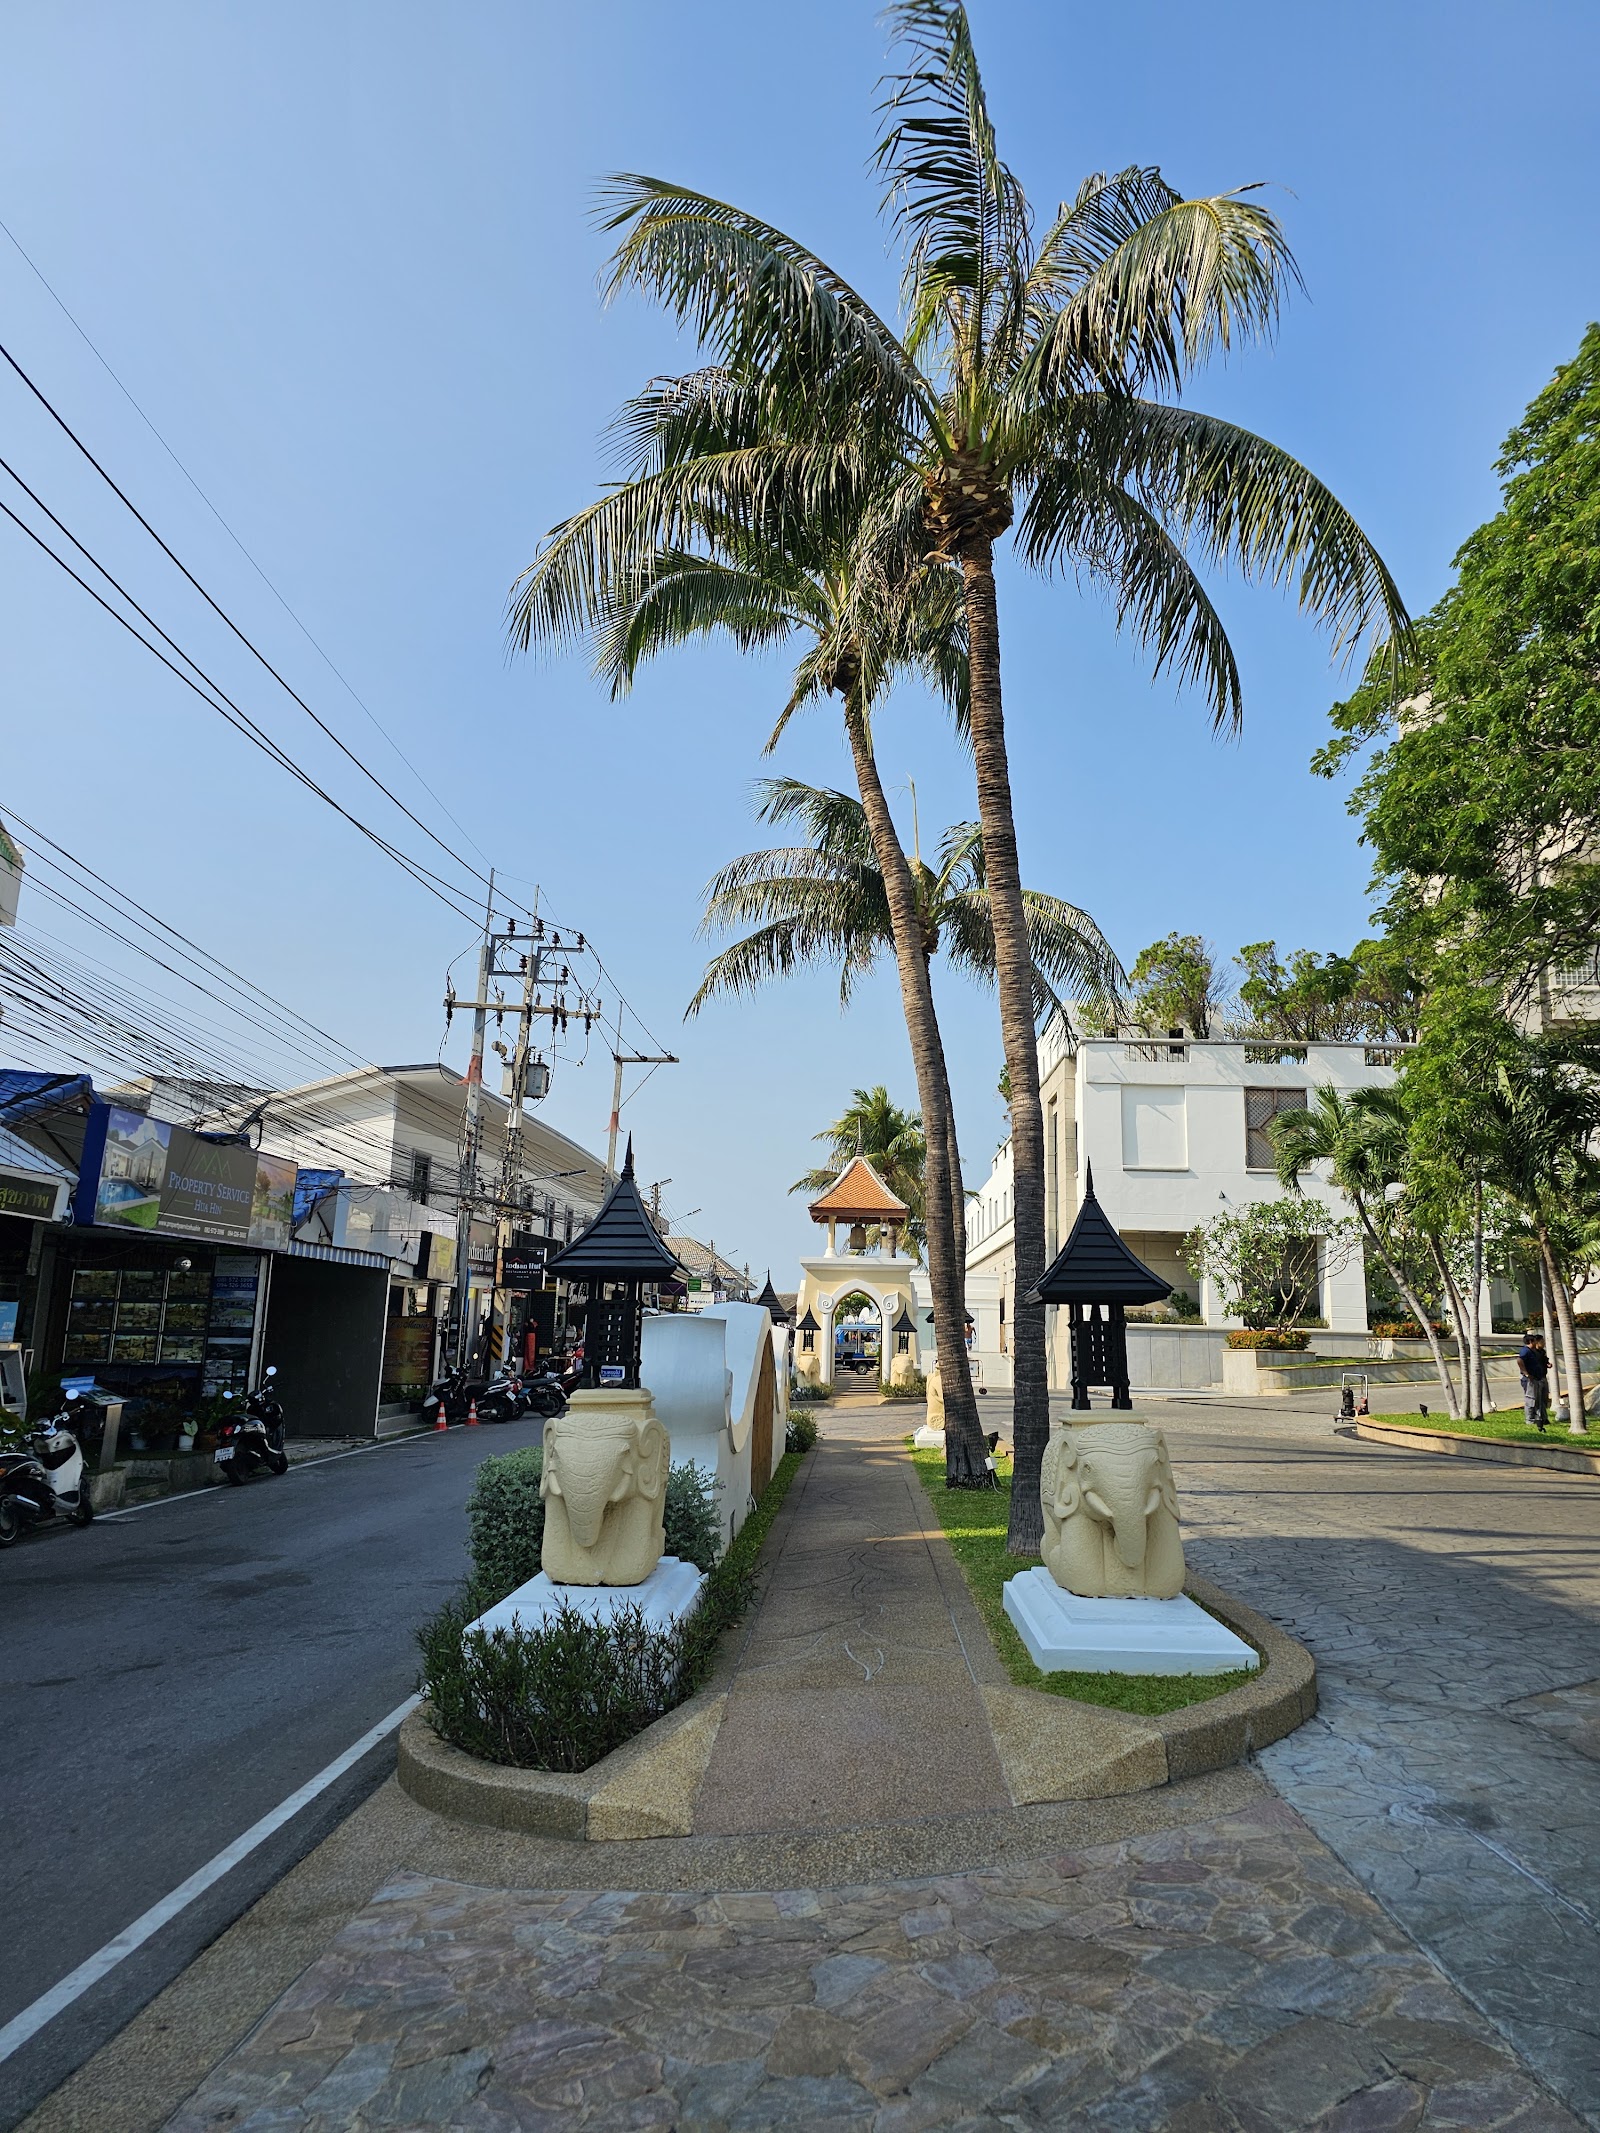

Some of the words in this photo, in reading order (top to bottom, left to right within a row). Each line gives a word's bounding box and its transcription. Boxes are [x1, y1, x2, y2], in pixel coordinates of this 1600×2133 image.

[168, 1171, 216, 1197] PROPERTY
[217, 1183, 250, 1204] SERVICE
[505, 1262, 528, 1270] Indian
[528, 1262, 542, 1270] Hut
